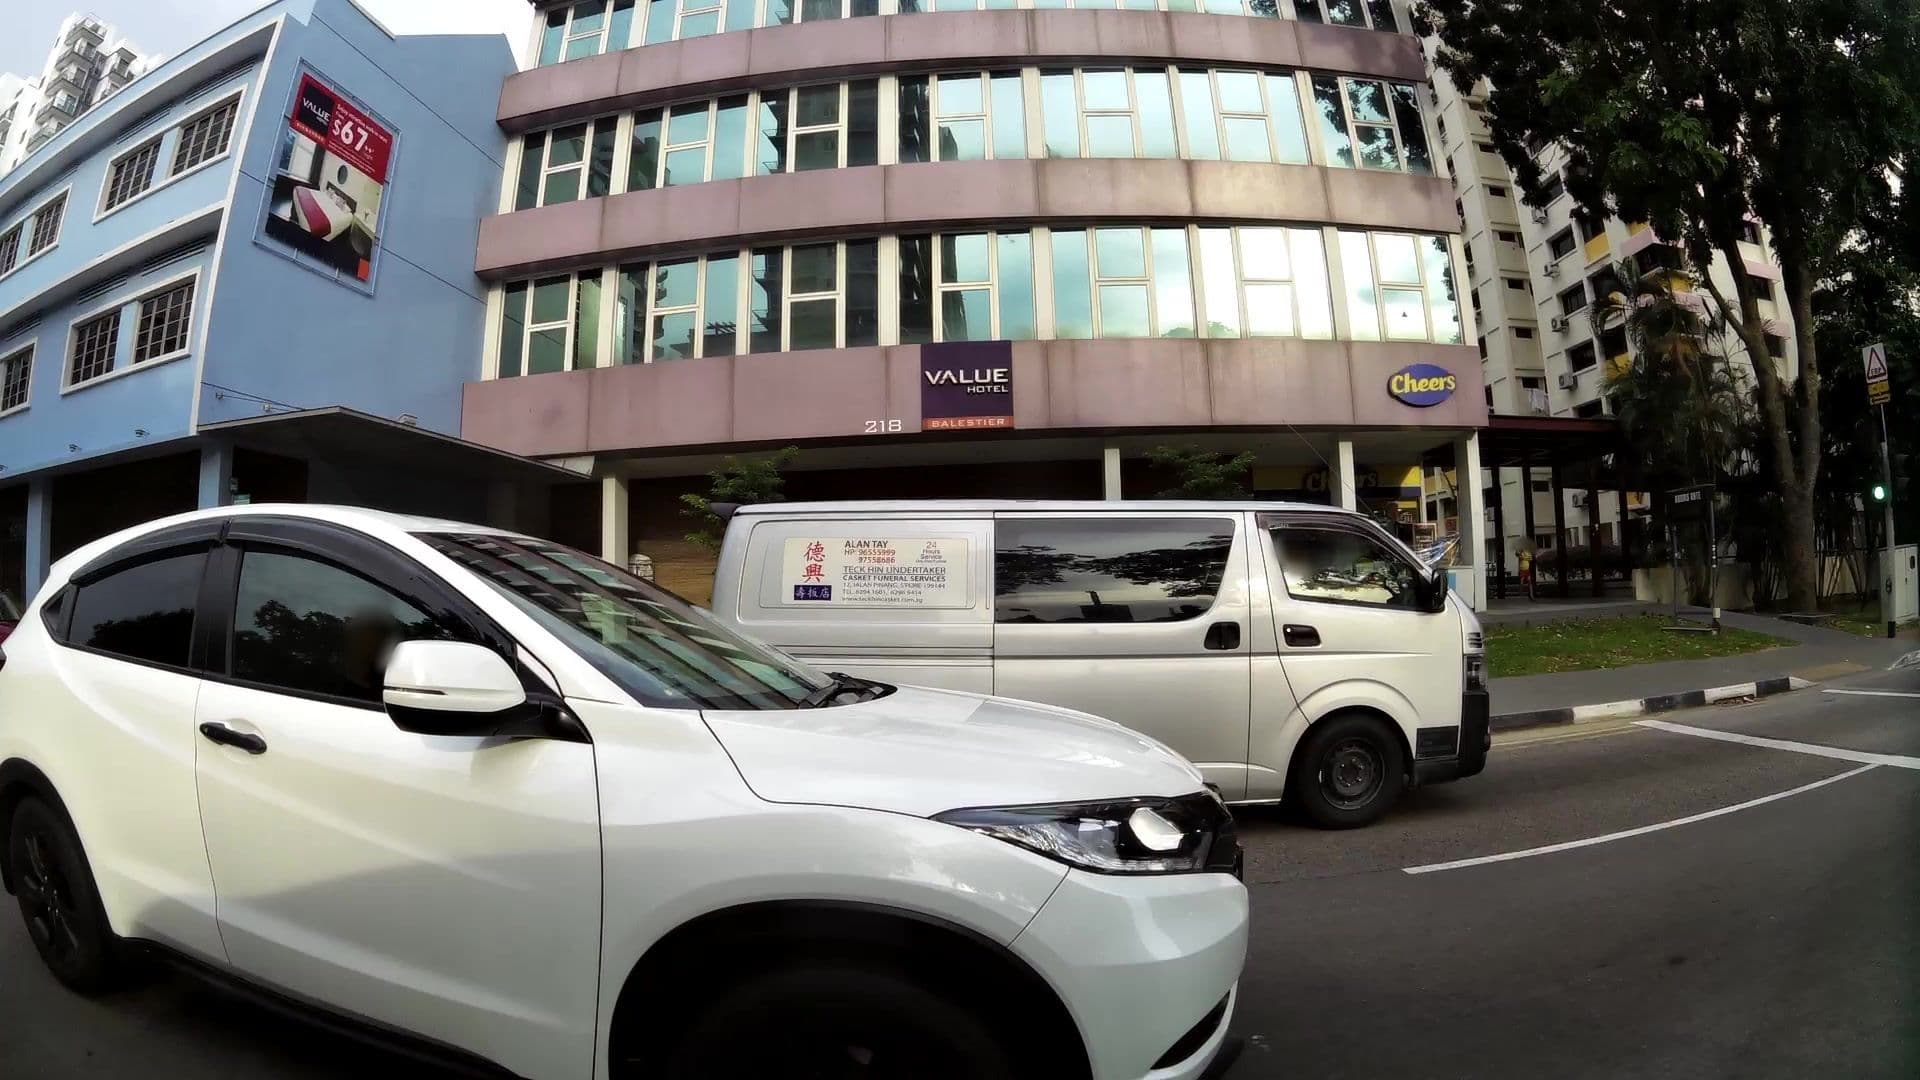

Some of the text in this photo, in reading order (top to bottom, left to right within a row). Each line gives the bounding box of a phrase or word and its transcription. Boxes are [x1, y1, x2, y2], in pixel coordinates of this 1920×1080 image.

[303, 97, 331, 122] VALUE
[925, 368, 1009, 385] VALUE
[1391, 372, 1456, 394] Cheers
[967, 385, 1009, 393] HOTEL
[865, 419, 902, 433] 218
[931, 418, 1005, 428] BALESTIER
[845, 540, 870, 548] ALAN
[926, 541, 937, 549] 24
[886, 566, 946, 574] UNDERTAKER
